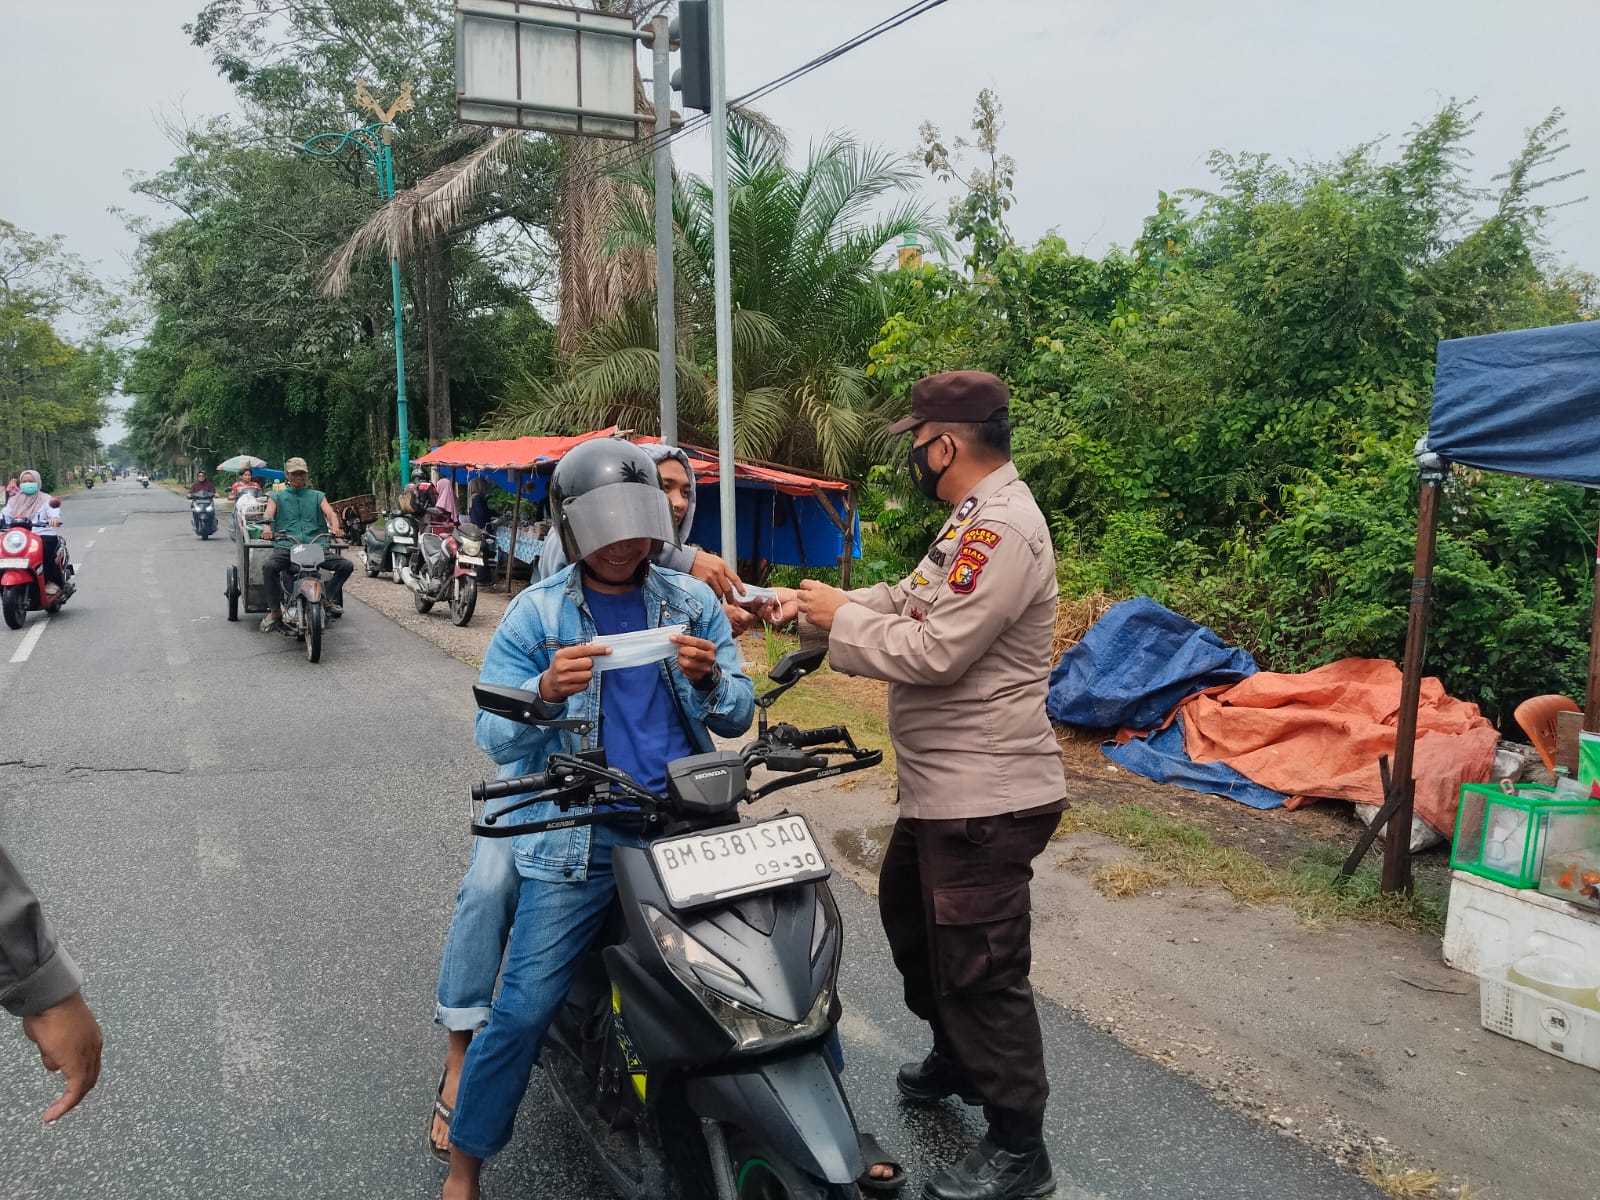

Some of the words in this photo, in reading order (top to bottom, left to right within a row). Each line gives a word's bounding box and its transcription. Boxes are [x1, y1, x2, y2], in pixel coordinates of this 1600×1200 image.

[966, 530, 997, 541] POLRES
[963, 548, 984, 560] RIAU
[694, 769, 728, 780] HONDA
[662, 845, 697, 870] BM
[700, 831, 758, 862] 6381
